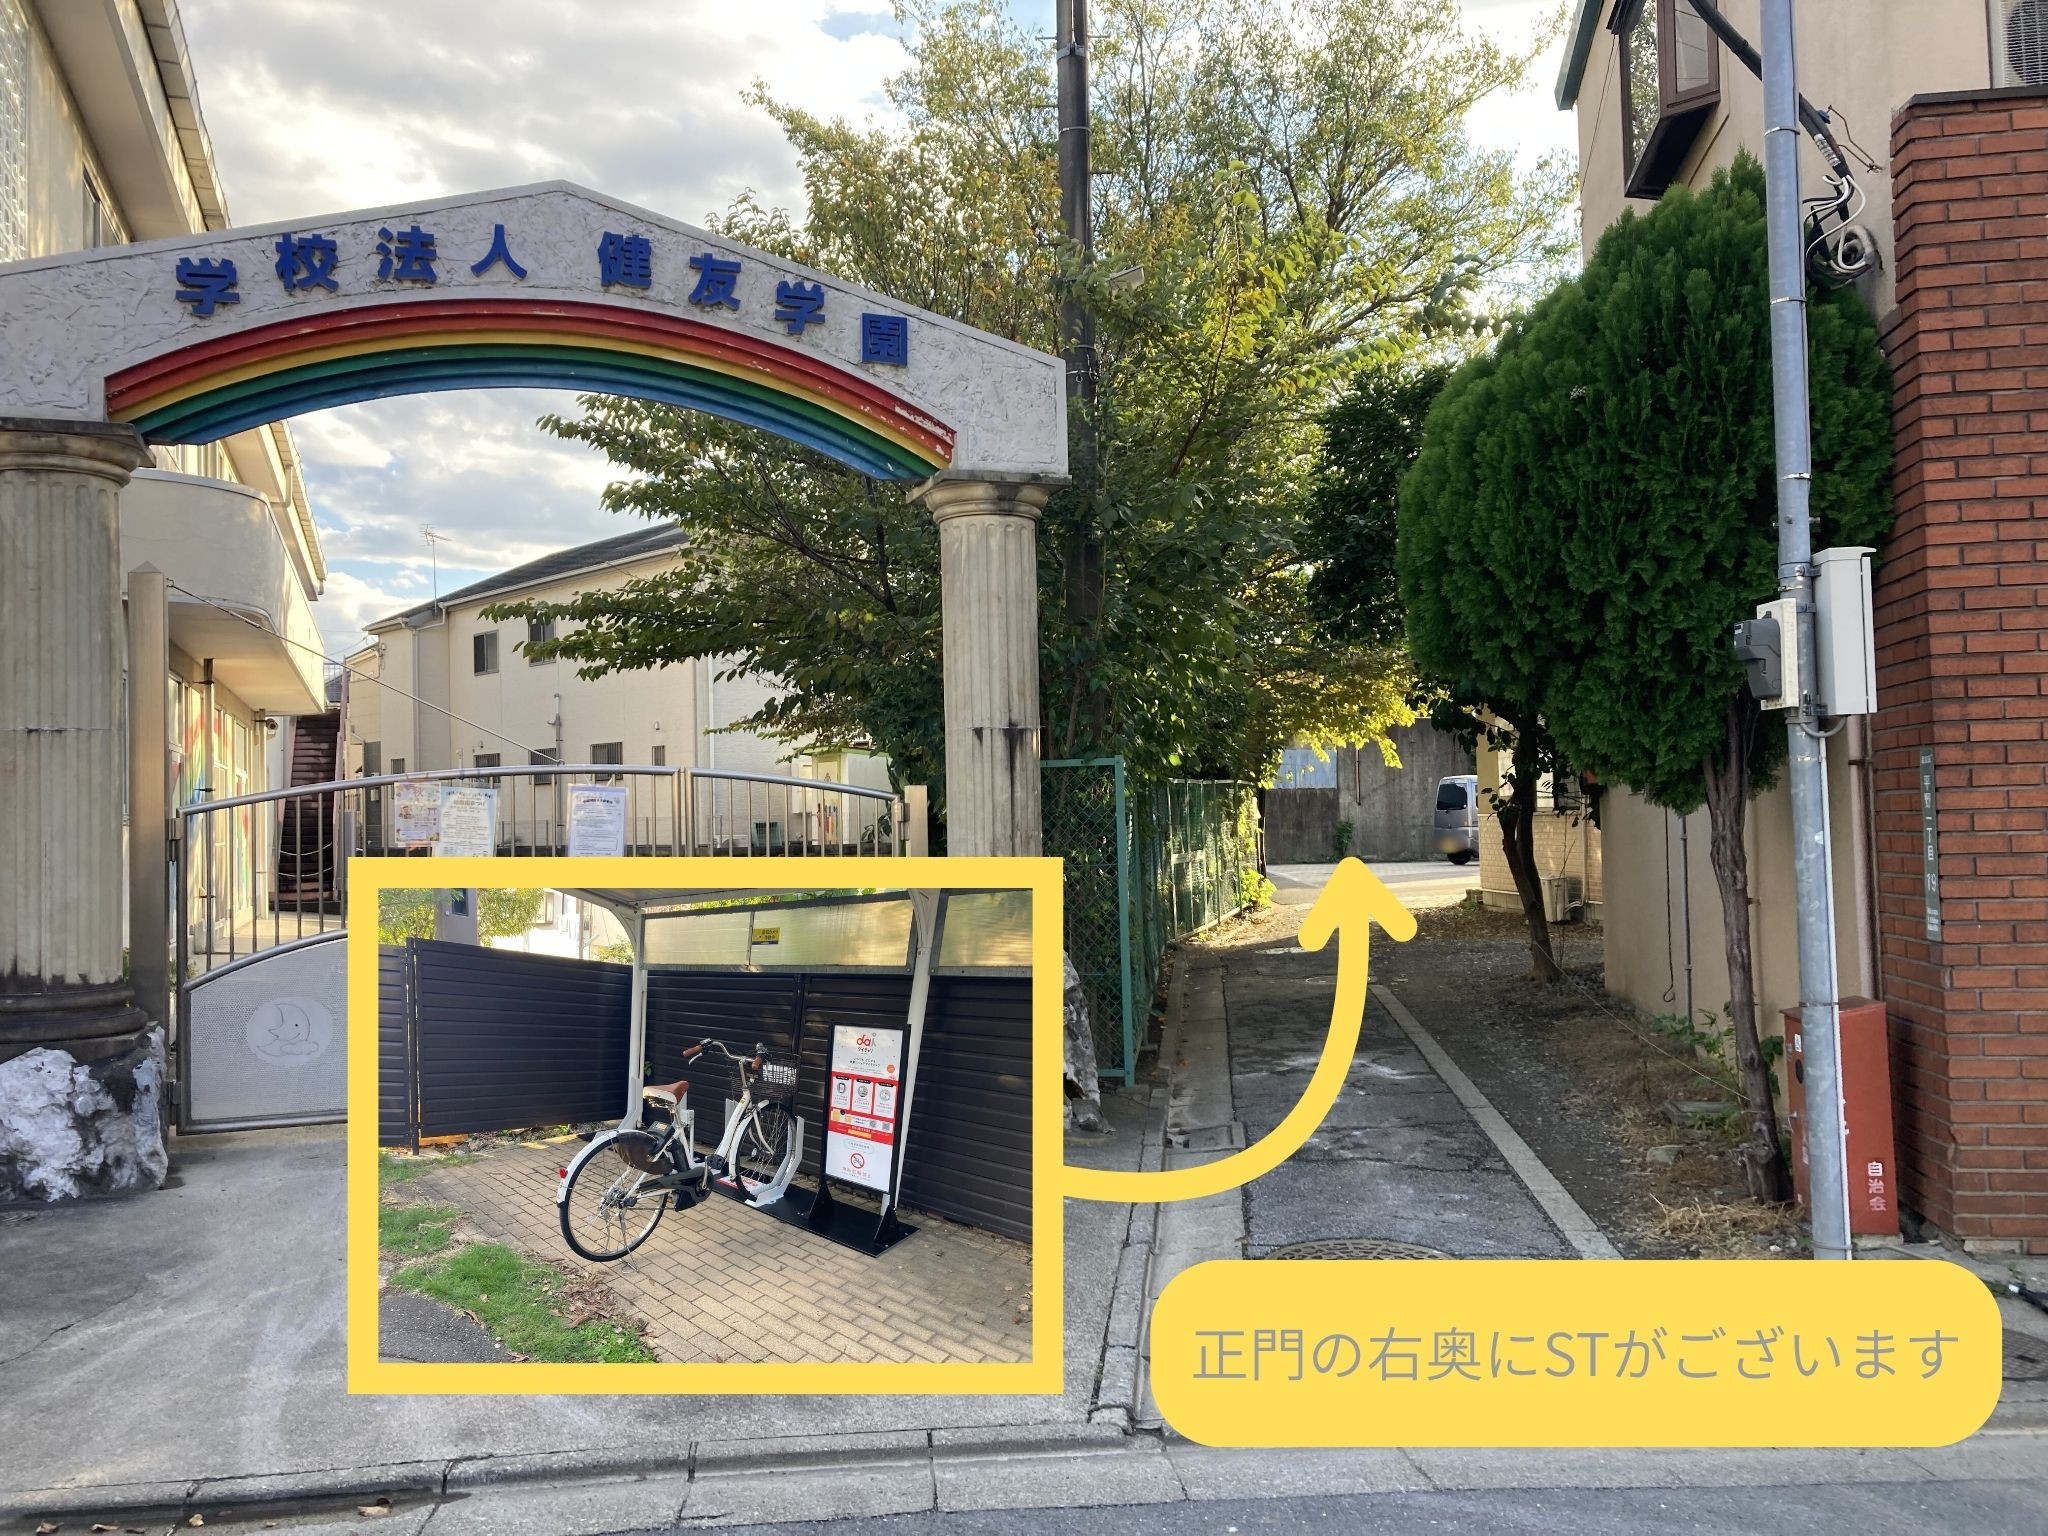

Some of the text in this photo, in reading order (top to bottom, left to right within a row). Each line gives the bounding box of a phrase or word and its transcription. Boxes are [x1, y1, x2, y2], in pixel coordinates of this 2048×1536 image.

[175, 224, 908, 367] 学校法人 健友学園
[1867, 1161, 1887, 1212] 自治会
